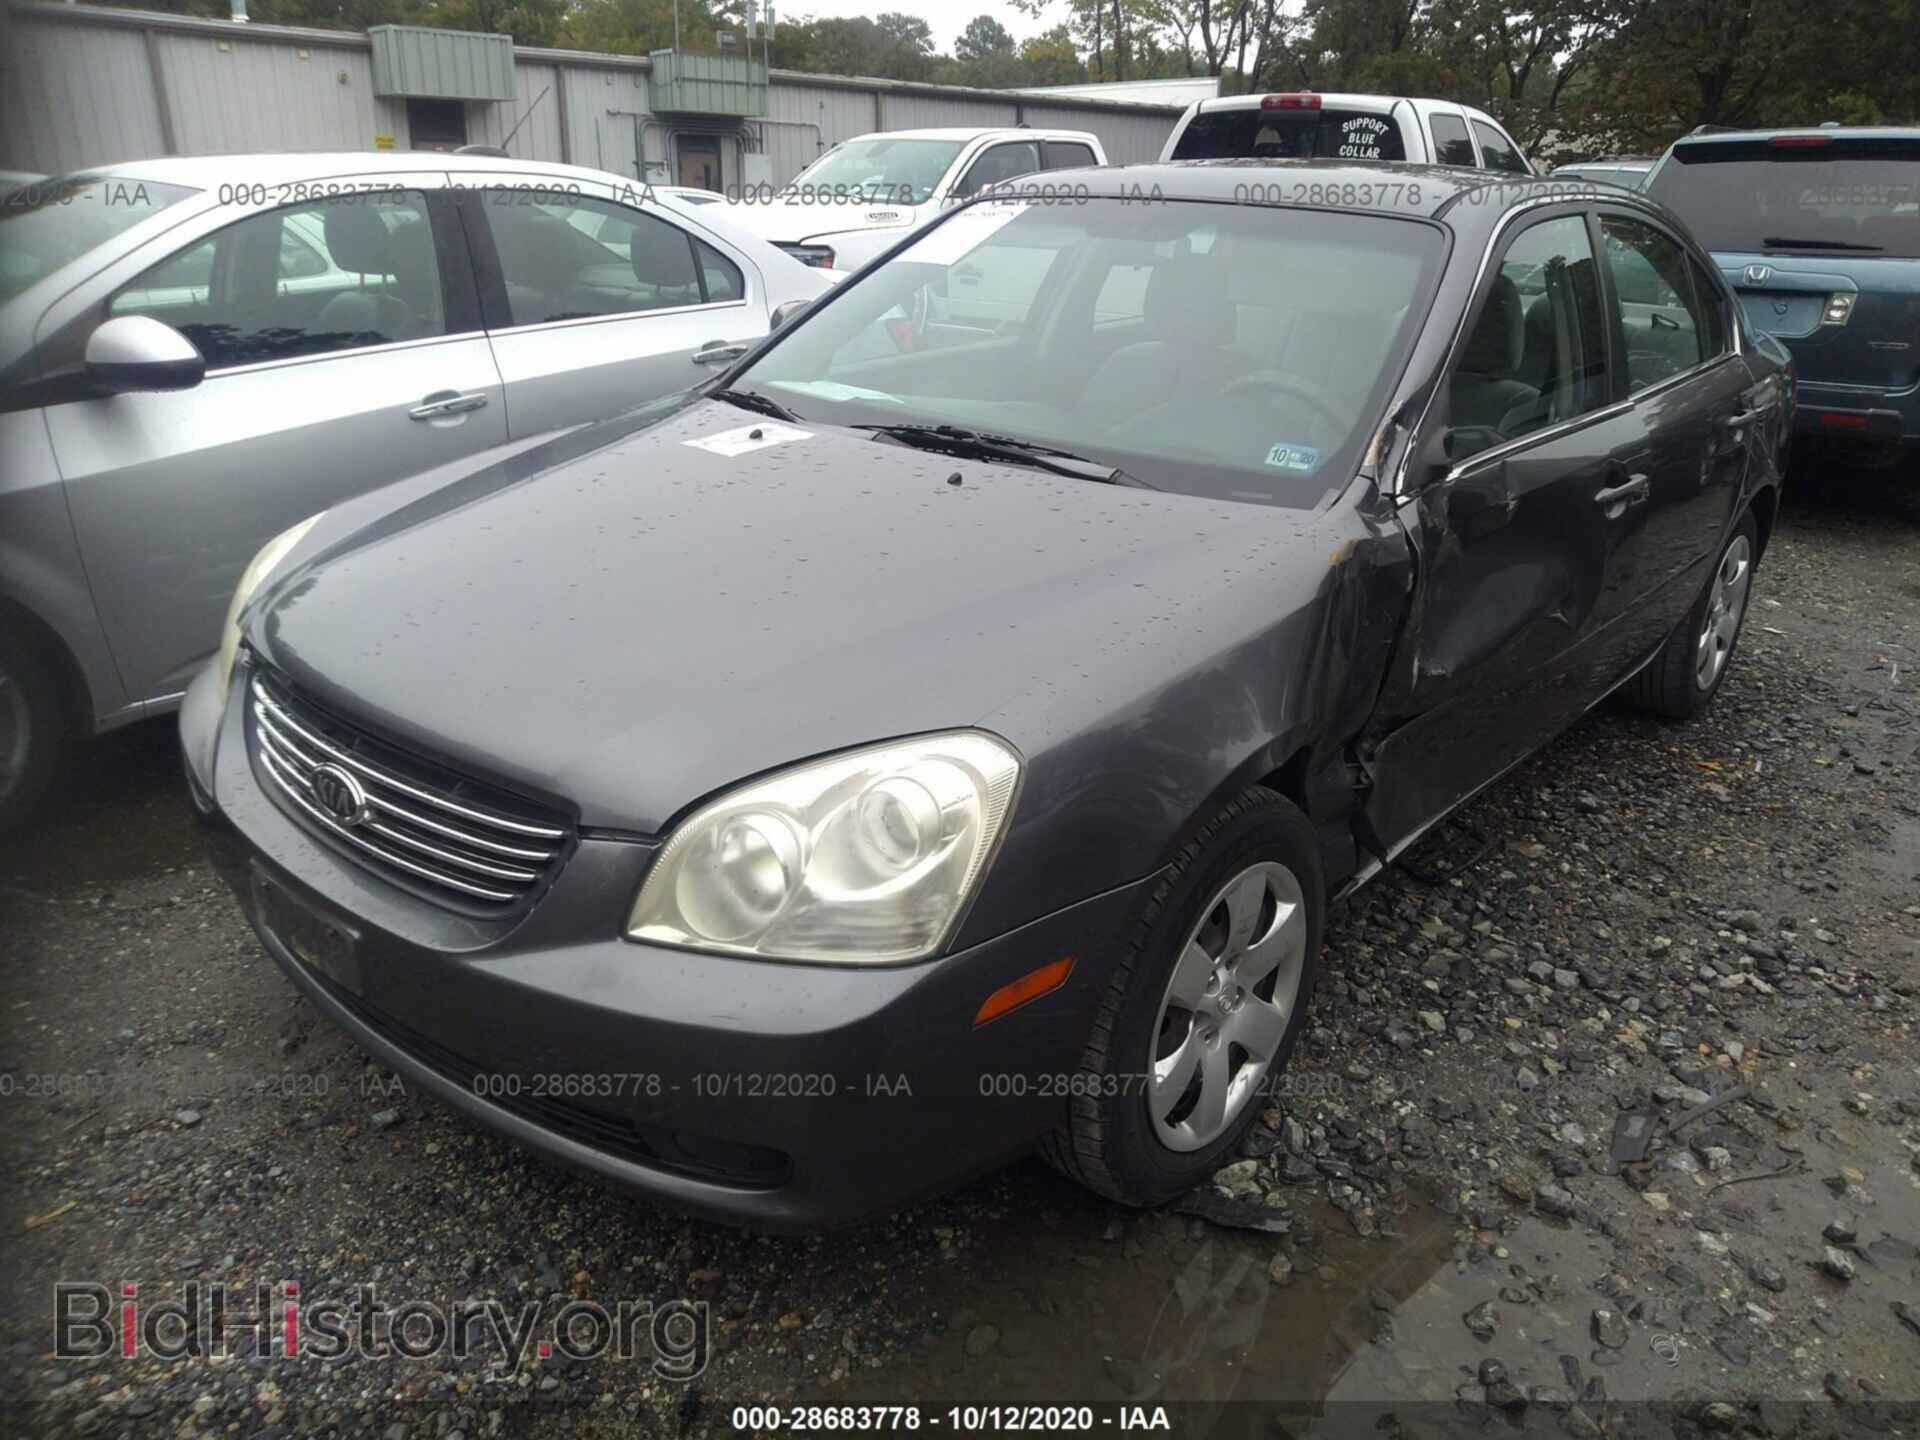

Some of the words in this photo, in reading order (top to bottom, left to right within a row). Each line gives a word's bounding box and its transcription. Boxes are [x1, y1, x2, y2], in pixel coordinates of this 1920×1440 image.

[1342, 117, 1389, 135] SUPPORT
[1348, 132, 1375, 145] BLUE
[1339, 144, 1380, 159] COLLAR
